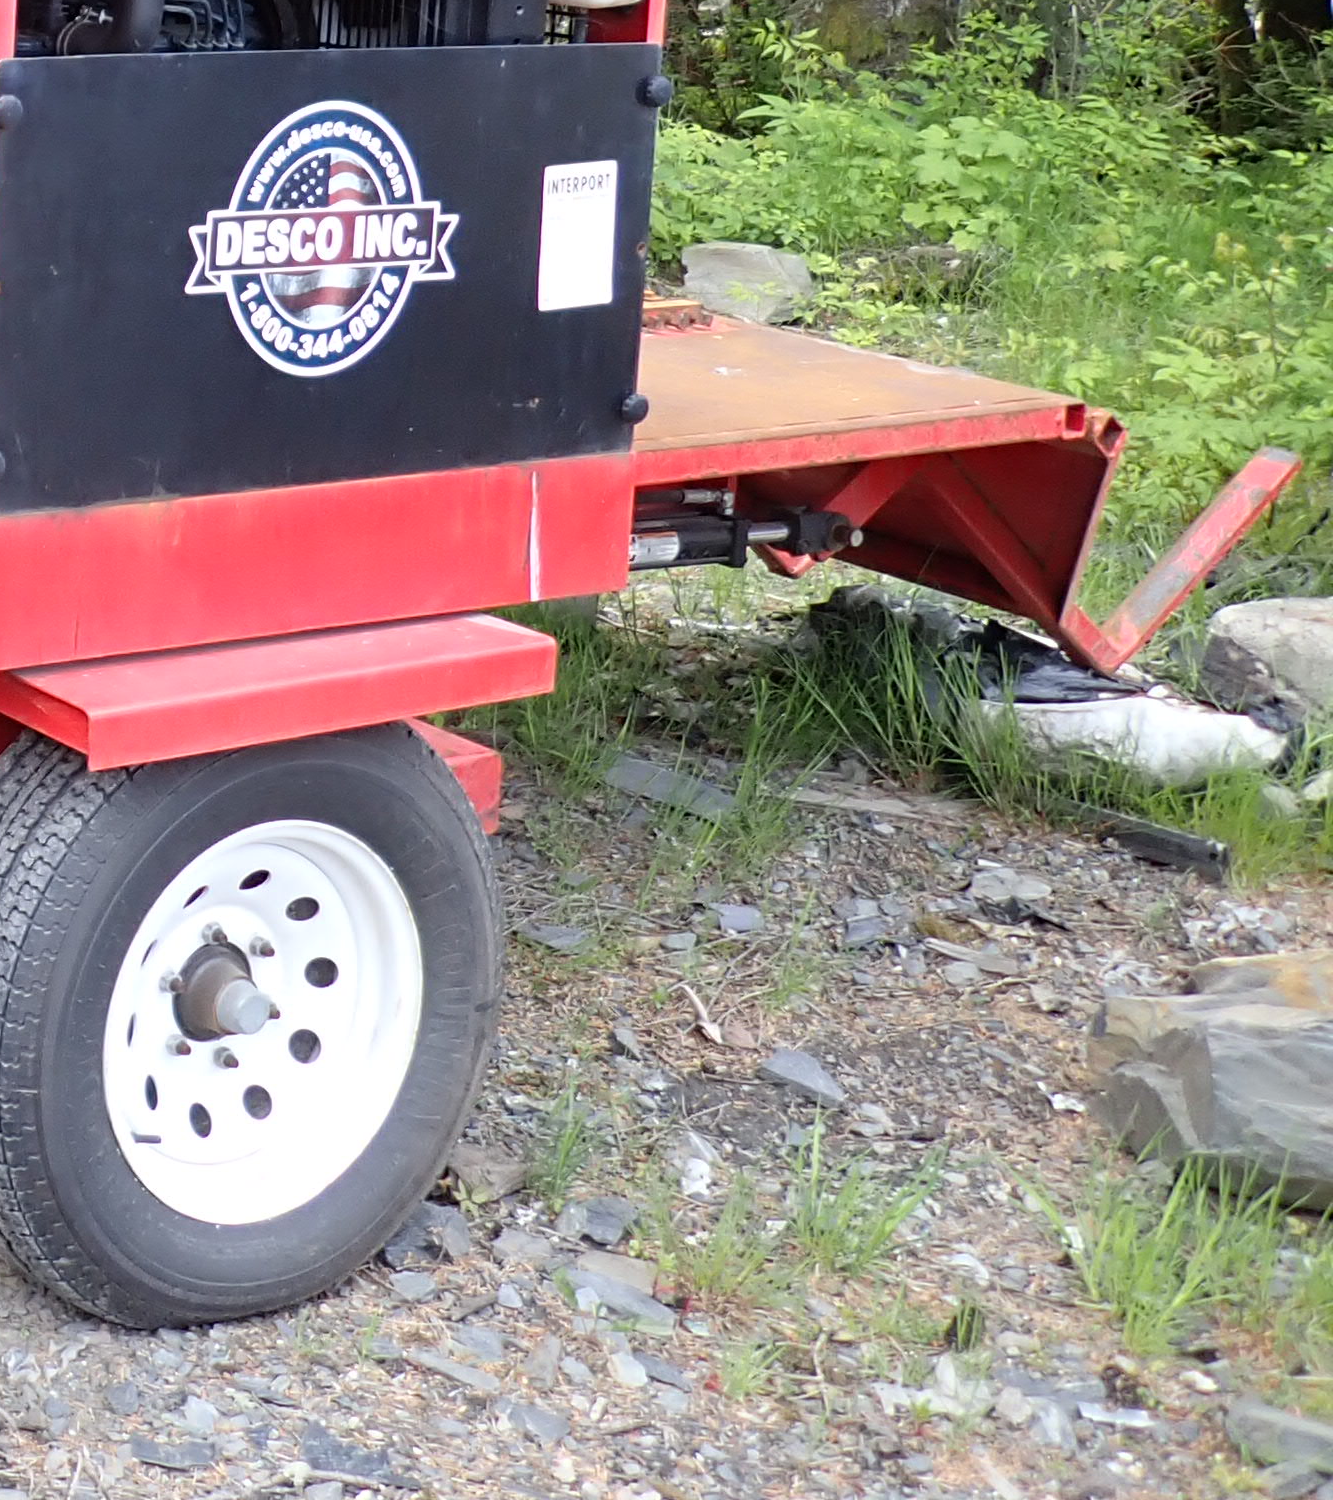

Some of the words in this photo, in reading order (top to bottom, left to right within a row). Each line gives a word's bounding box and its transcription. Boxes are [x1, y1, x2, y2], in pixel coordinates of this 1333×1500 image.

[247, 121, 407, 202] www.desco-usa.com
[547, 173, 611, 195] INTERPORT
[215, 216, 344, 266] DESCO
[350, 212, 428, 259] INC.
[240, 273, 400, 359] 1-800-344-0814
